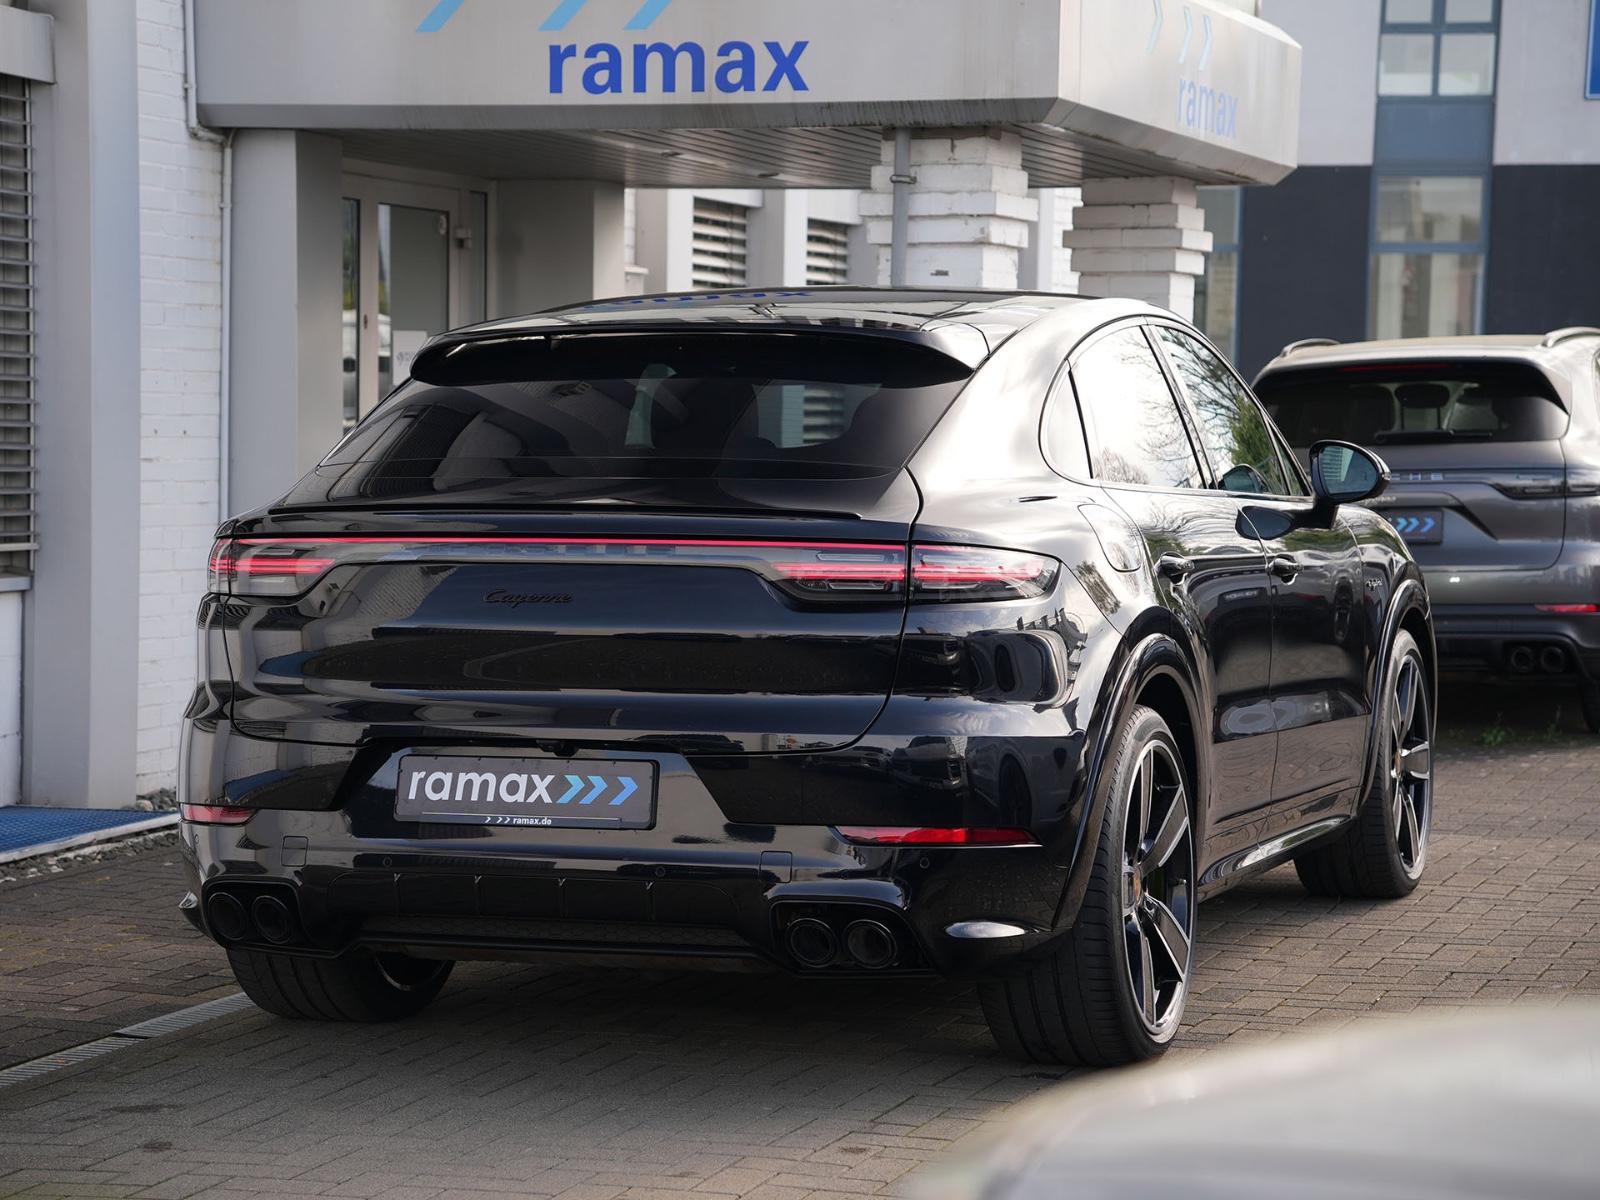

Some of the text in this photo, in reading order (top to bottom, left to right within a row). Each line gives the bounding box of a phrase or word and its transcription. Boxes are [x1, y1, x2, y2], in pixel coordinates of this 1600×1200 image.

[548, 40, 810, 95] ramax
[1177, 78, 1240, 138] ramax
[407, 770, 556, 804] ramax
[512, 816, 552, 826] ramax.de
